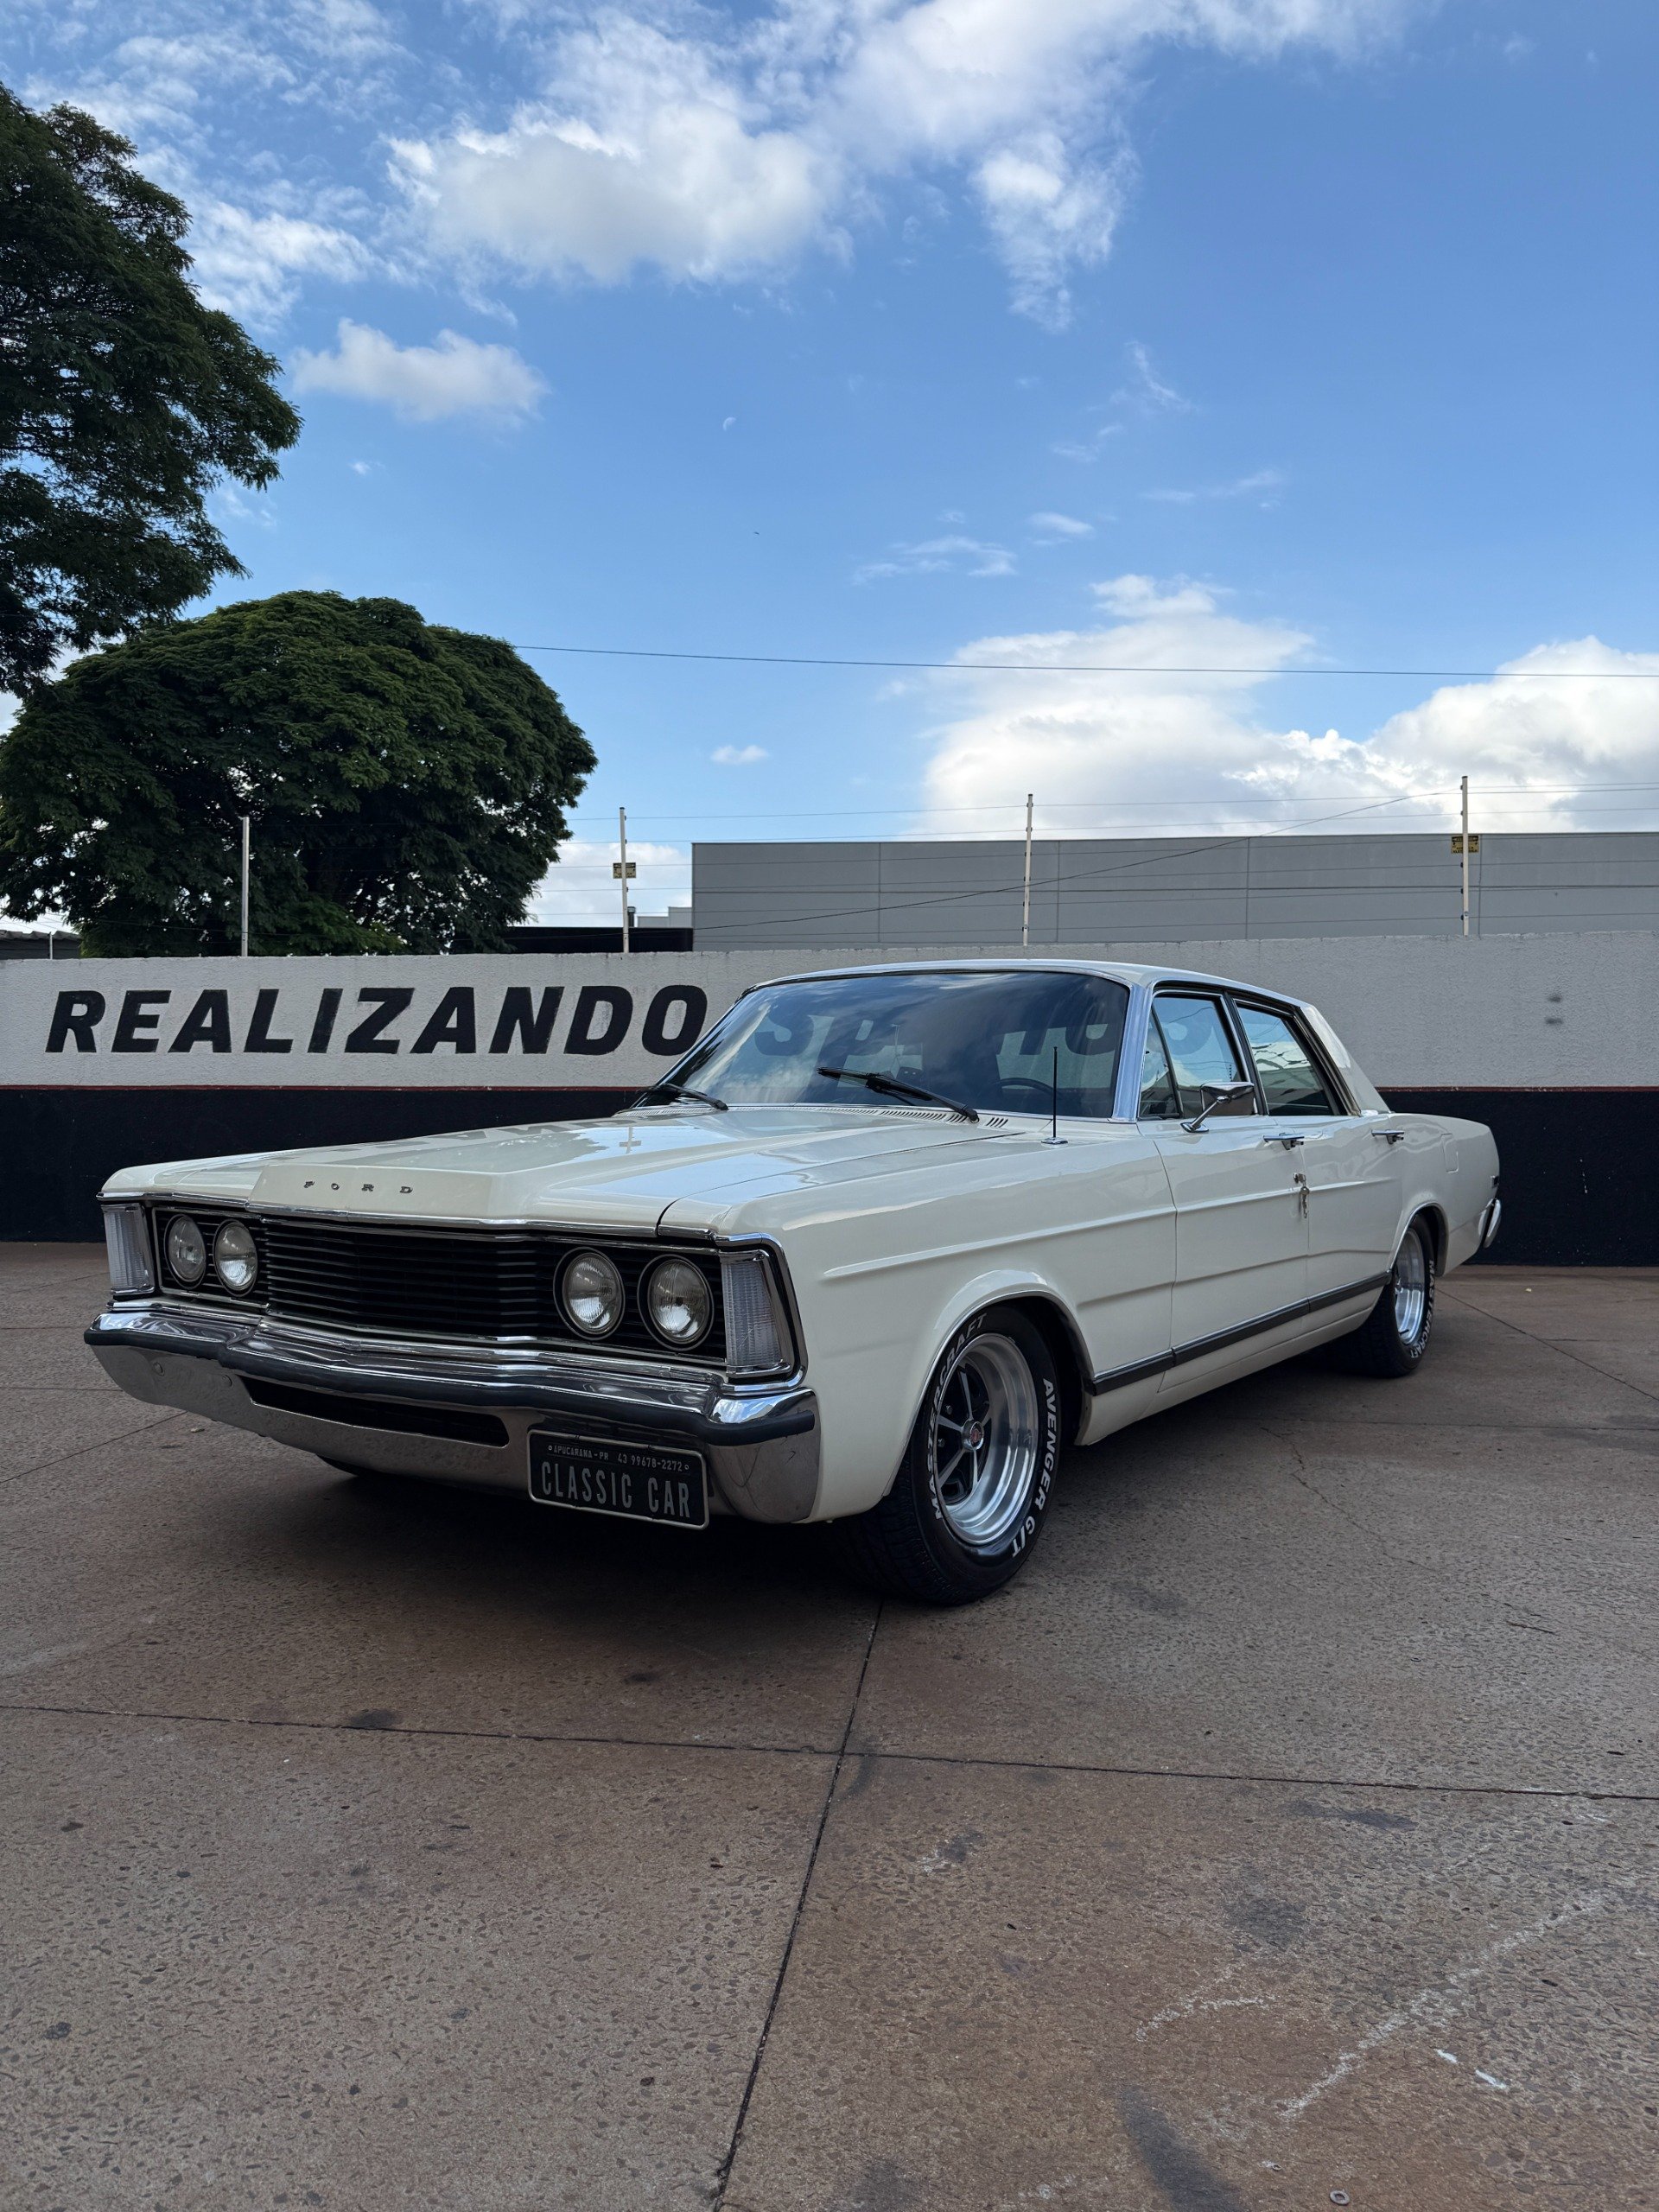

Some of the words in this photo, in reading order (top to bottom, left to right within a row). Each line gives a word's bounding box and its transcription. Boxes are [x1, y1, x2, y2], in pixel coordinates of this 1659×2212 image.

[46, 983, 709, 1056] REALIZANDO
[303, 1180, 413, 1194] FORD
[1408, 1259, 1436, 1359] MASTERCRAFT
[927, 1312, 988, 1521] MASTERCRAFT
[1035, 1377, 1059, 1511] AVENGER
[541, 1461, 632, 1510] CLASSIC
[647, 1477, 690, 1518] CAR
[617, 1452, 627, 1464] 43
[631, 1456, 683, 1472] 99678-2272
[1011, 1515, 1036, 1558] G/T
